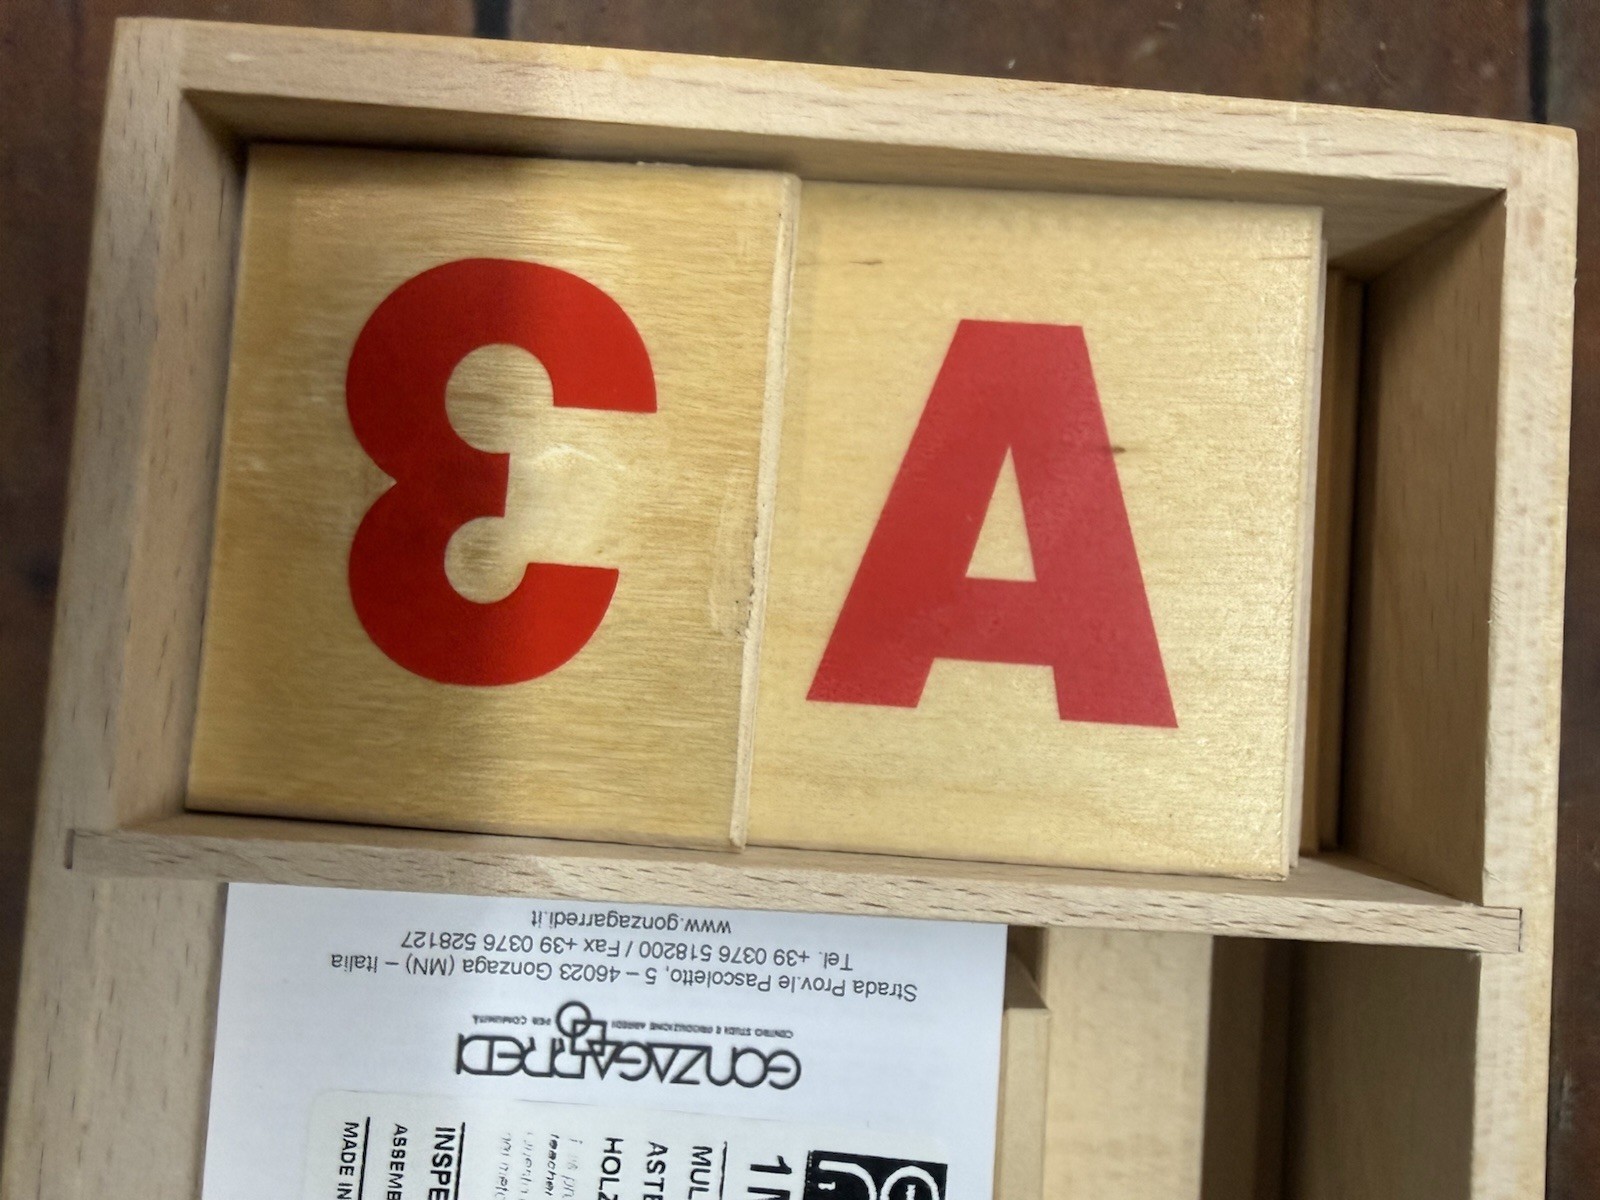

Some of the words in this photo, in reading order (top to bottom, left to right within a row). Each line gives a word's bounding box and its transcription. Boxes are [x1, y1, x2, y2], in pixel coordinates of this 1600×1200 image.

[345, 257, 657, 687] 3
[805, 317, 1179, 729] A
[531, 909, 732, 934] www.gonzagarredi.it
[401, 931, 476, 950] 528127
[483, 933, 533, 952] 0376
[540, 936, 578, 954] +39
[583, 939, 620, 957] Fax
[639, 940, 712, 962] 518200
[331, 954, 378, 973] Italia
[405, 953, 455, 977] (MN)
[719, 945, 767, 965] 0376
[772, 947, 810, 967] +39
[820, 951, 853, 971] Tel.
[462, 959, 552, 981] Gonzaga
[559, 962, 621, 982] 46023
[645, 966, 657, 985] 5
[665, 966, 771, 992] Pascoletto,
[778, 974, 846, 997] Prov.le
[853, 979, 918, 1002] Strada
[339, 1122, 359, 1176] MADE
[428, 1127, 456, 1200] INSPE
[336, 1182, 354, 1200] IN
